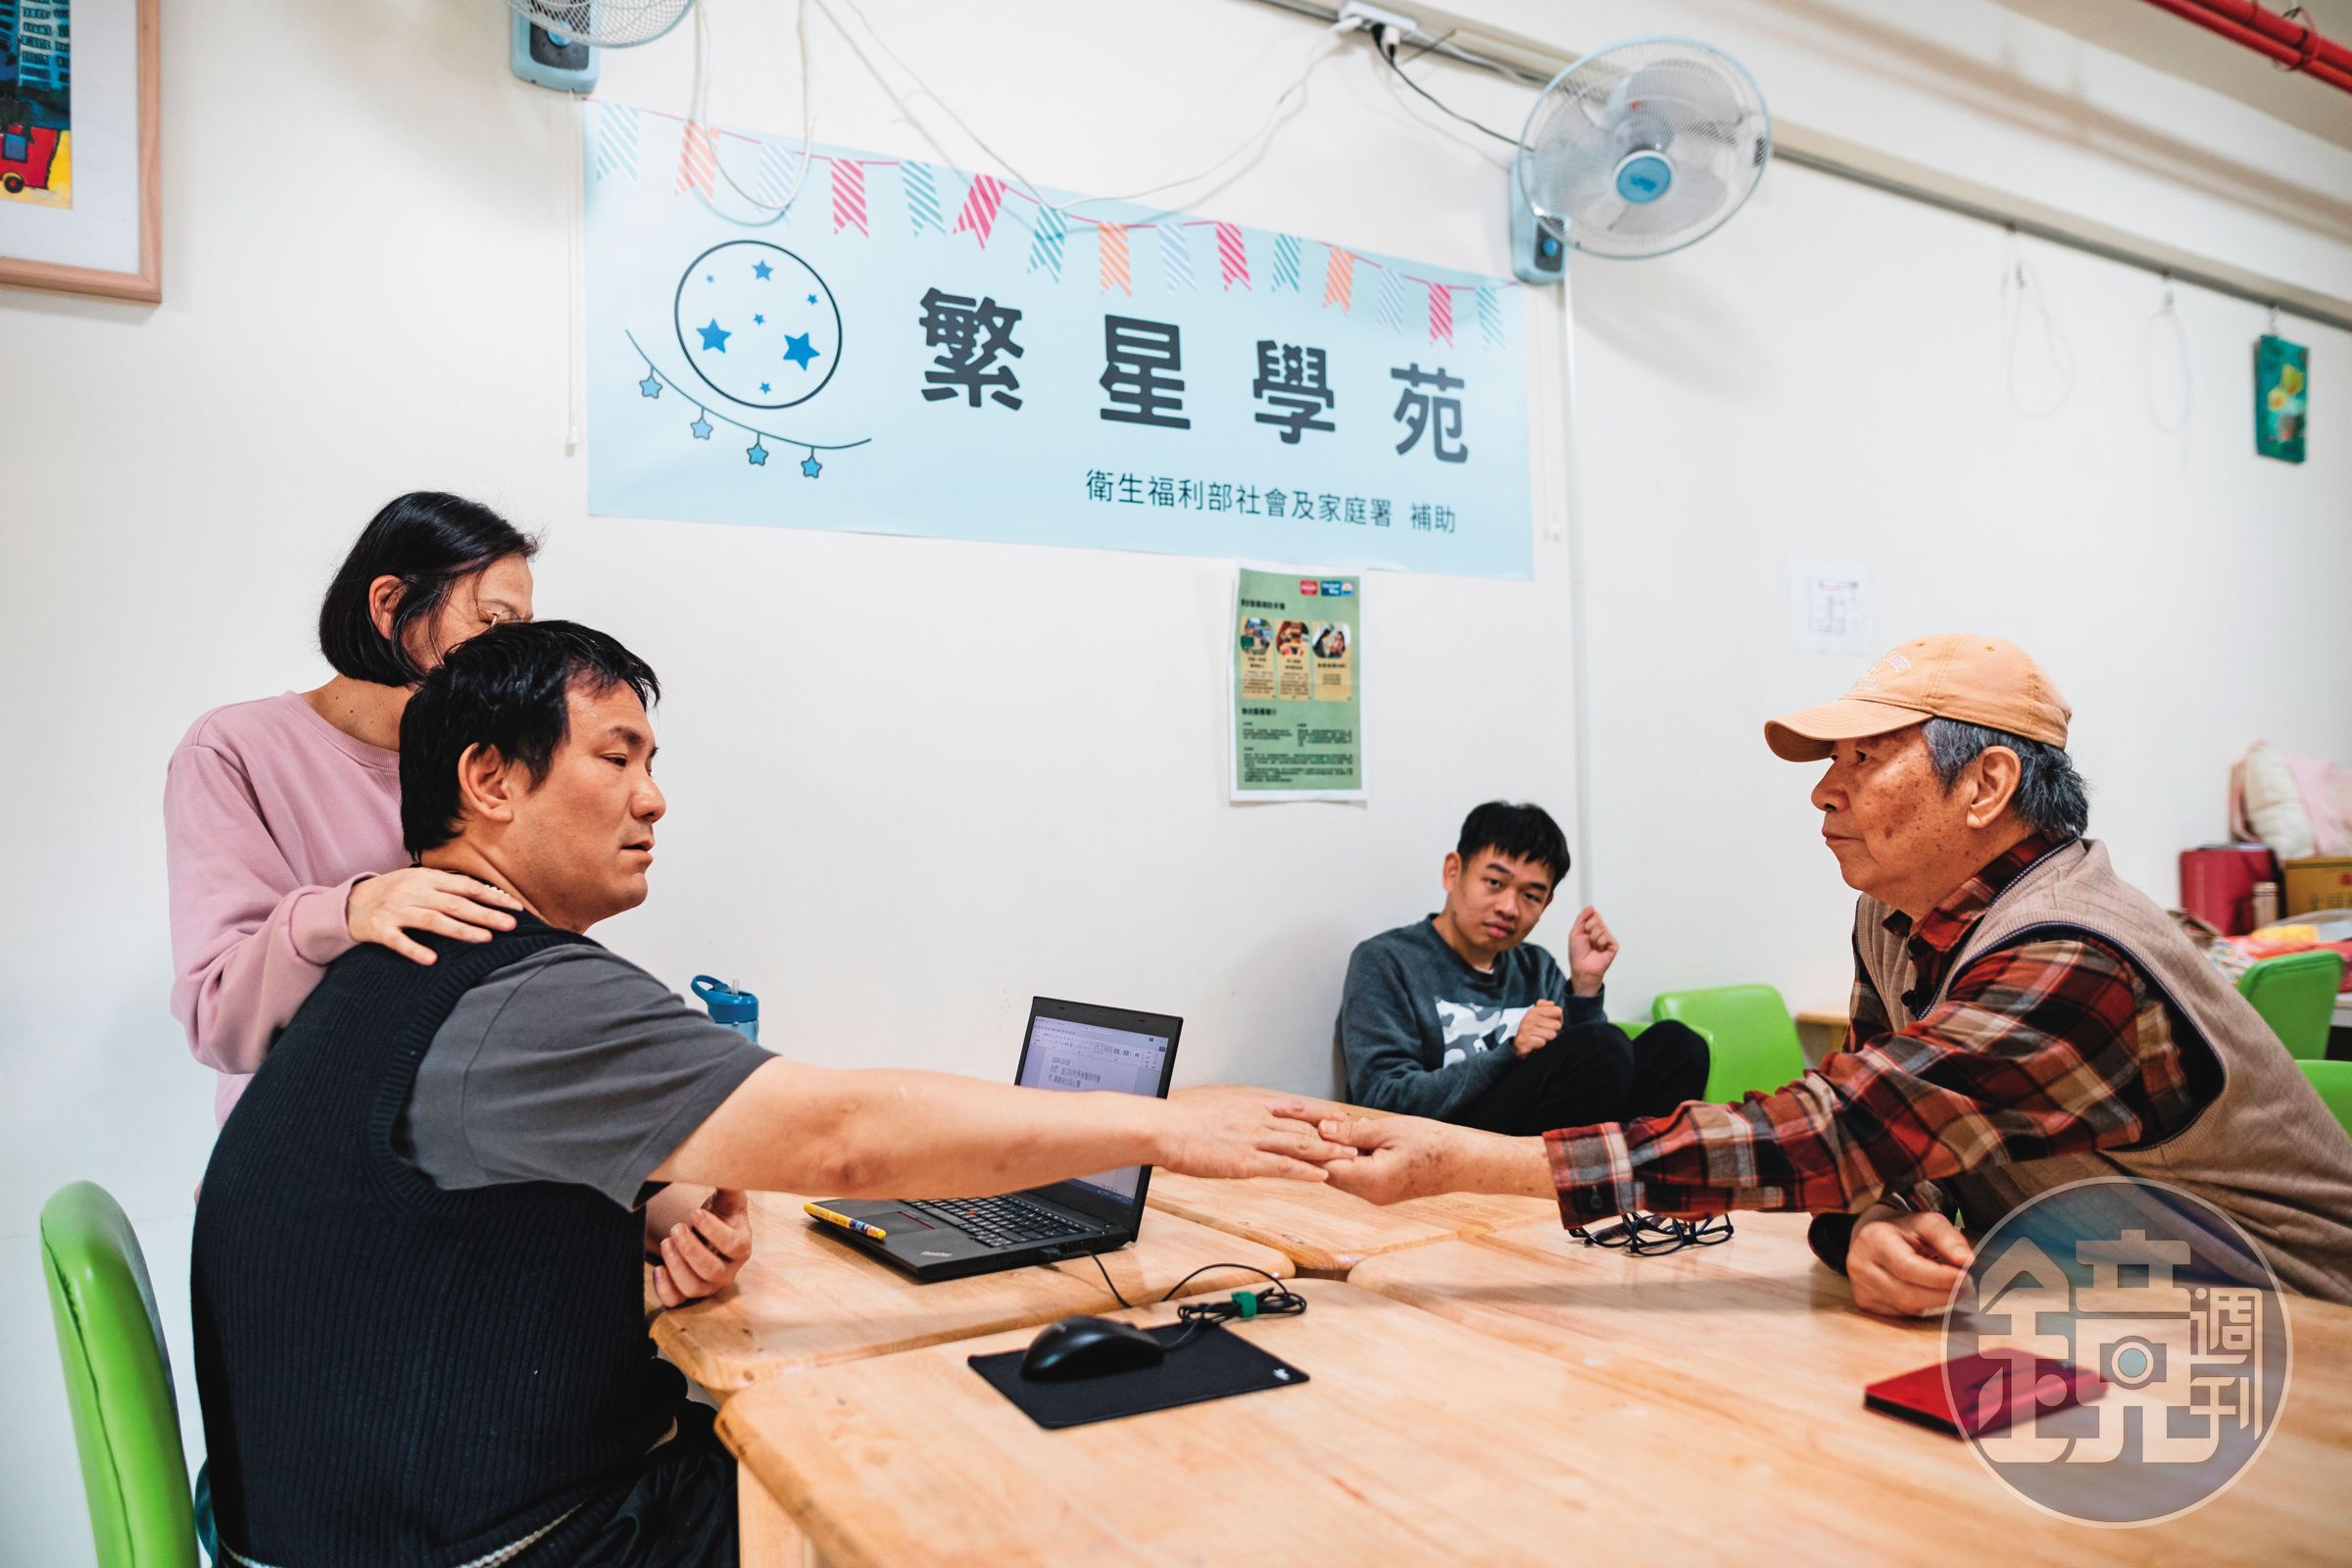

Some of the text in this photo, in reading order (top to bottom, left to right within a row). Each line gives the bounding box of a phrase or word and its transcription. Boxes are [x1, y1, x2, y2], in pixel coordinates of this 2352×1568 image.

[919, 287, 1468, 464] 繁星學苑
[1086, 468, 1455, 534] 衛生福利部社會及家庭署 補助
